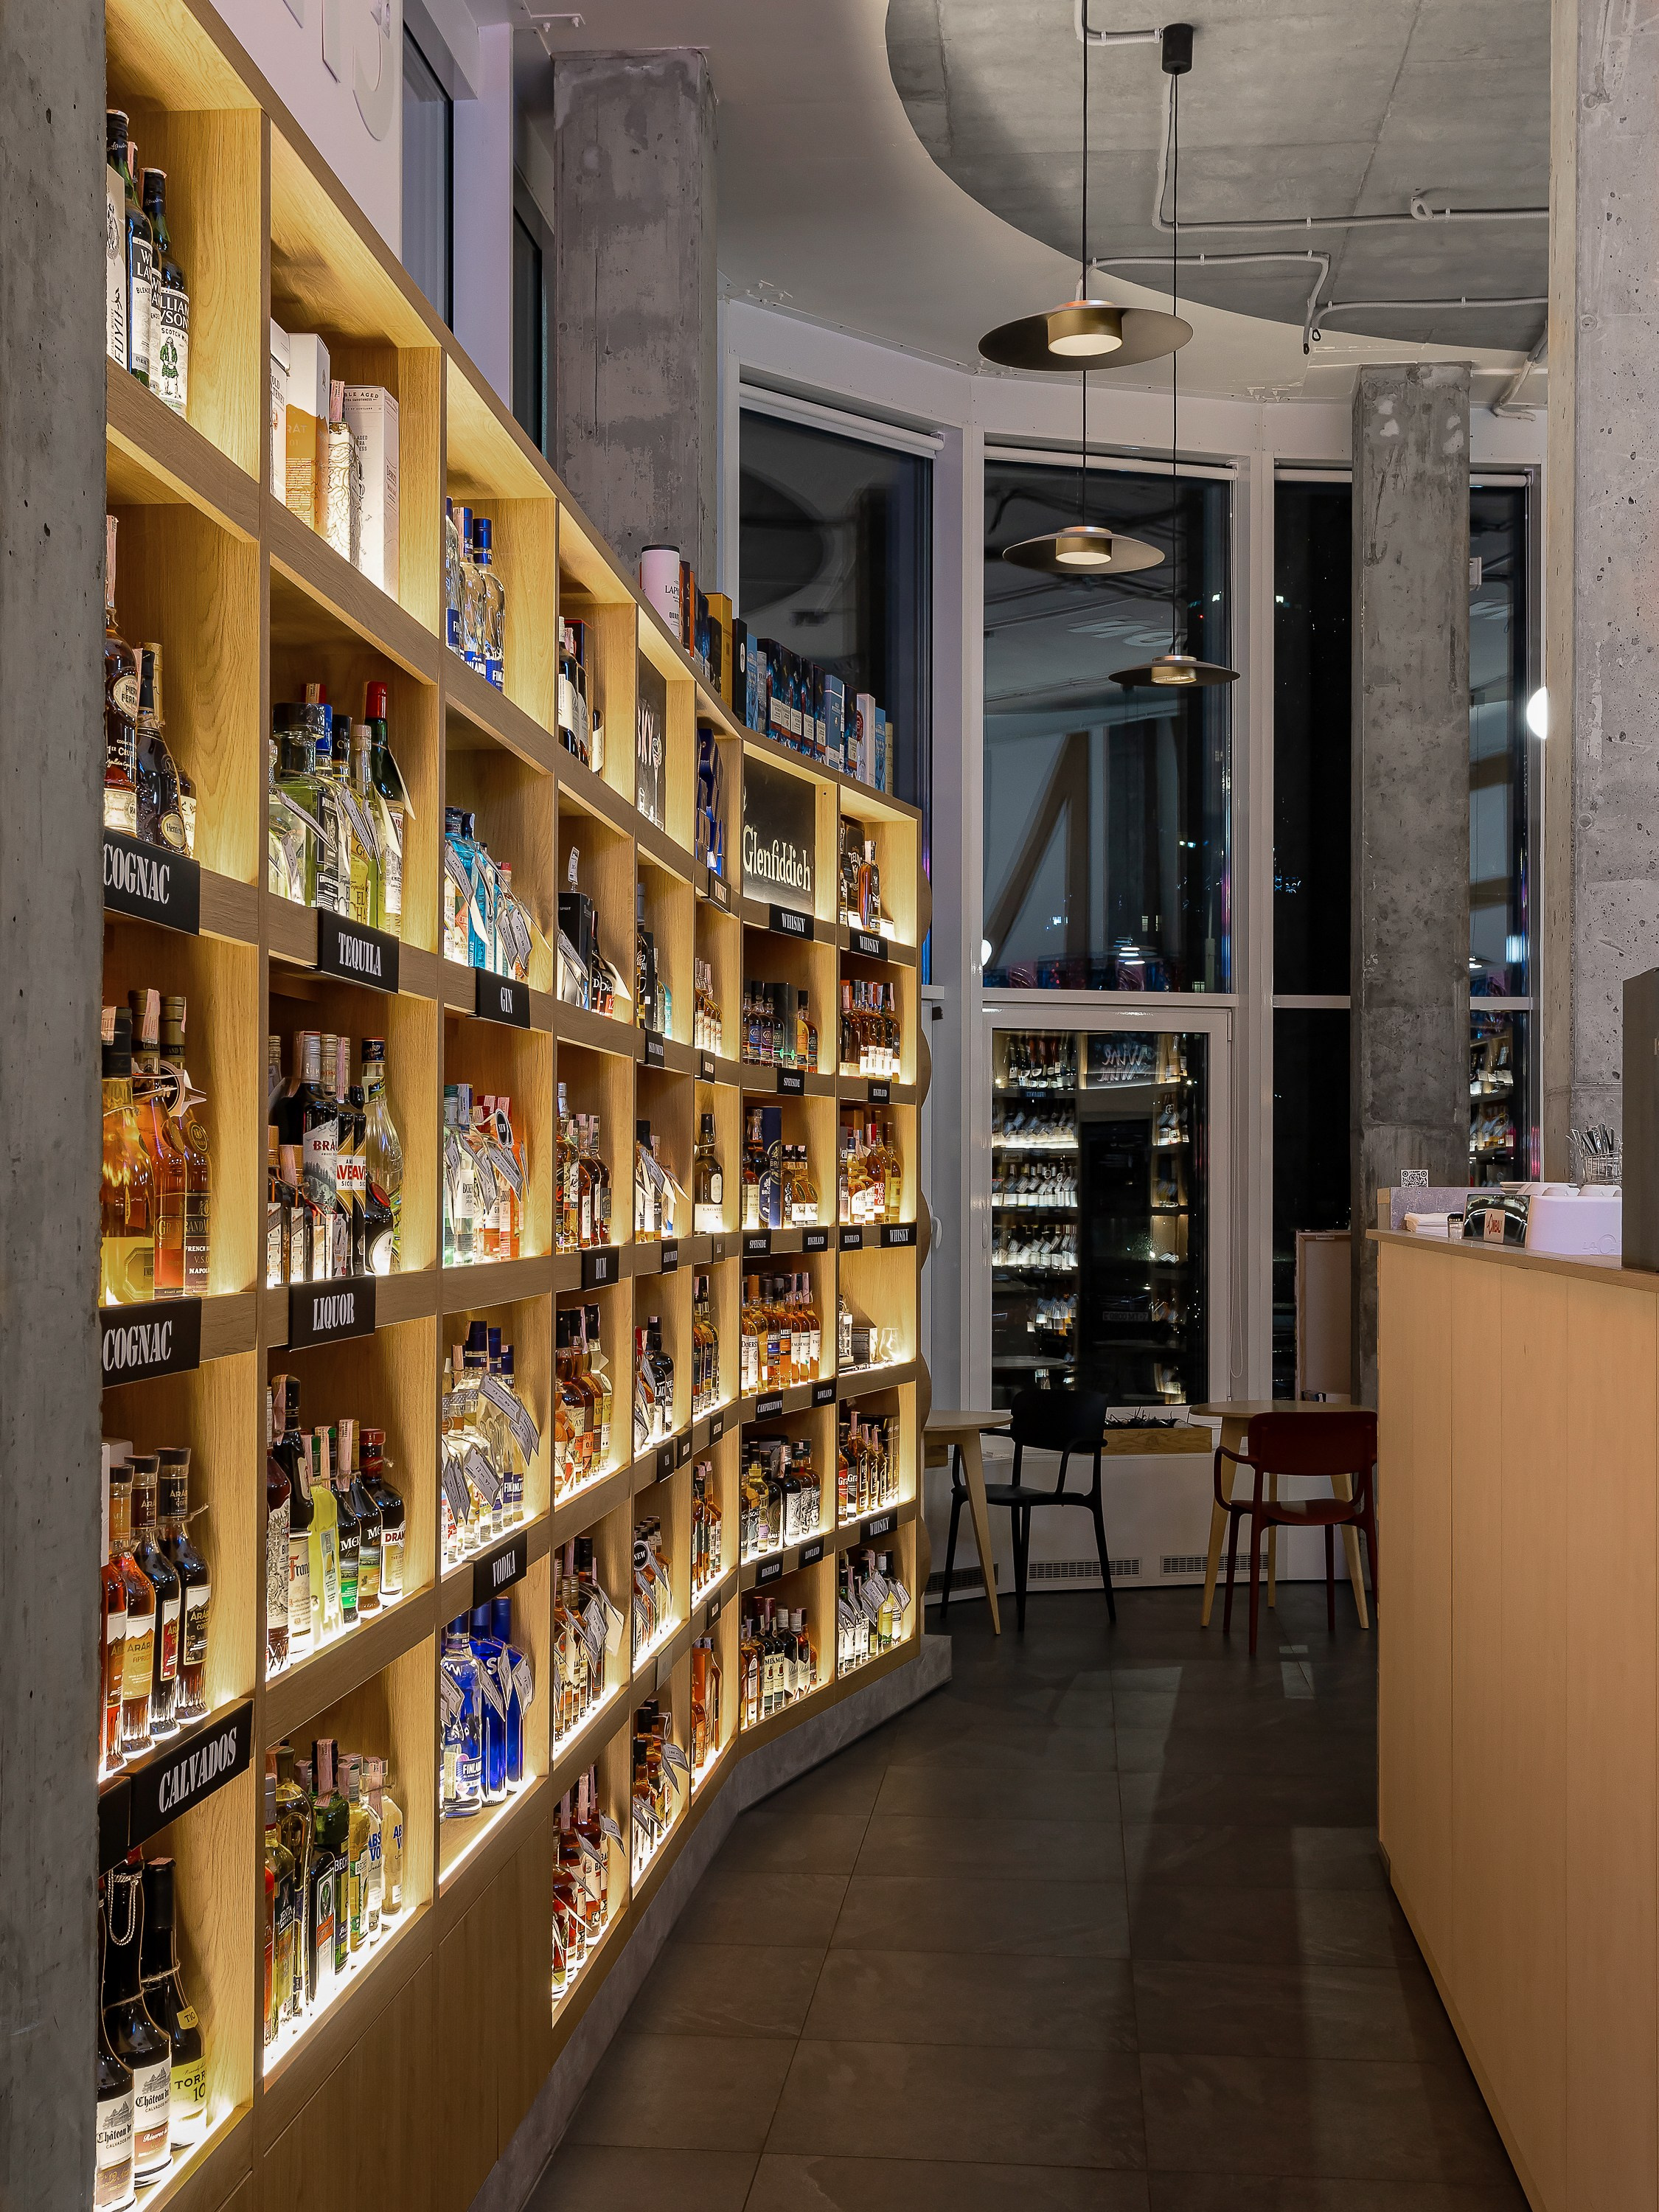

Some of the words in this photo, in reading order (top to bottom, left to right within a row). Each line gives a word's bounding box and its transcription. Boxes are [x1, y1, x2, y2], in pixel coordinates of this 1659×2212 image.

[743, 824, 812, 891] Glenfiddich
[103, 843, 170, 904] COGNAC
[782, 912, 805, 933] WHISKY
[859, 935, 880, 953] WHISKY
[338, 931, 382, 977] TEQUILA
[500, 987, 513, 1014] GIN
[783, 1077, 801, 1088] SPEYSIDE
[749, 1239, 767, 1249] SPEYSIDE
[807, 1236, 824, 1245] HIGHLAND
[844, 1234, 860, 1243] HIGHLAND
[889, 1228, 909, 1242] WHISKY
[596, 1257, 607, 1279] RUM
[313, 1293, 355, 1331] LIQUOR
[103, 1320, 173, 1371] COGNAC
[817, 1388, 832, 1399] LOWLAND
[757, 1399, 783, 1413] CAMPBELTOWN
[869, 1516, 890, 1536] WHISKY
[634, 1550, 646, 1561] NEW
[804, 1546, 820, 1559] LOWLAND
[492, 1550, 515, 1587] VODKA
[762, 1563, 780, 1578] HIGHLAND
[158, 1727, 237, 1814] CALVADOS
[135, 2093, 164, 2108] Château
[97, 2126, 126, 2144] Château
